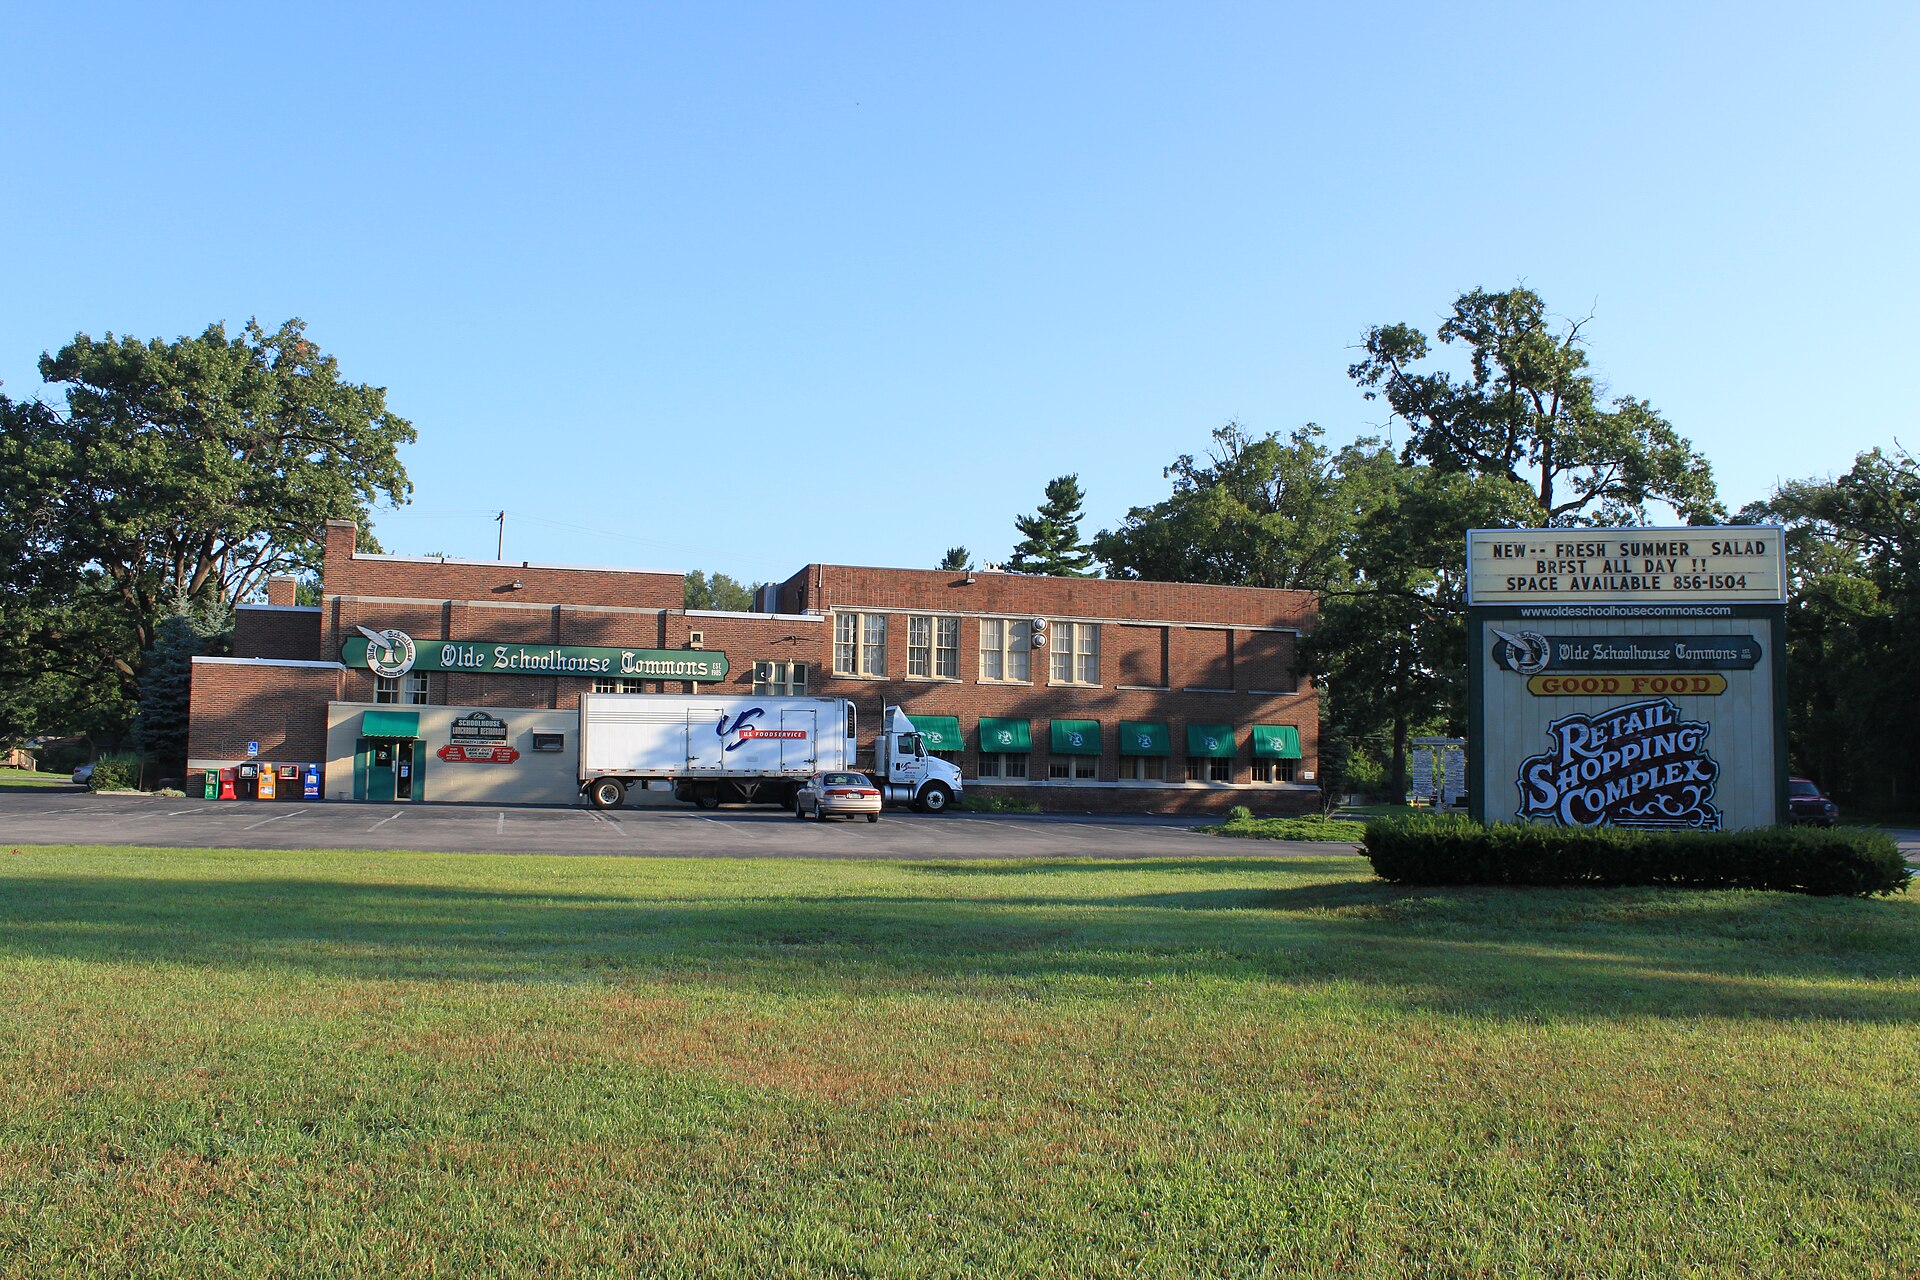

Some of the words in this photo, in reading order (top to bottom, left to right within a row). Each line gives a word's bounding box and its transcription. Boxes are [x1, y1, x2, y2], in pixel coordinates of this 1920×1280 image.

[1555, 543, 1606, 557] FRESH
[1619, 542, 1690, 557] SUMMER
[1711, 541, 1766, 556] SALAD
[1536, 560, 1587, 574] BRFST
[1602, 559, 1632, 574] ALL
[1644, 558, 1677, 573] DAY
[1506, 577, 1558, 591] SPACE
[1570, 576, 1661, 590] AVAILABLE
[1673, 575, 1747, 589] 856-1504
[1520, 605, 1732, 617] www.oldeschoolhousecommons.com
[1558, 643, 1589, 660] Olde
[1592, 643, 1671, 660] Schoolhouse
[1674, 642, 1738, 660] Commons
[440, 644, 485, 667] Olde
[493, 646, 611, 672] Schoolhouse
[620, 650, 708, 676] Commons
[1541, 677, 1621, 693] GOOD
[1630, 676, 1712, 692] FOOD
[458, 719, 501, 728] SCHOOLHOUSE
[1558, 704, 1673, 767] RETAIL
[1528, 727, 1705, 811] SHOPPING
[1560, 758, 1712, 828] COMPLEX
